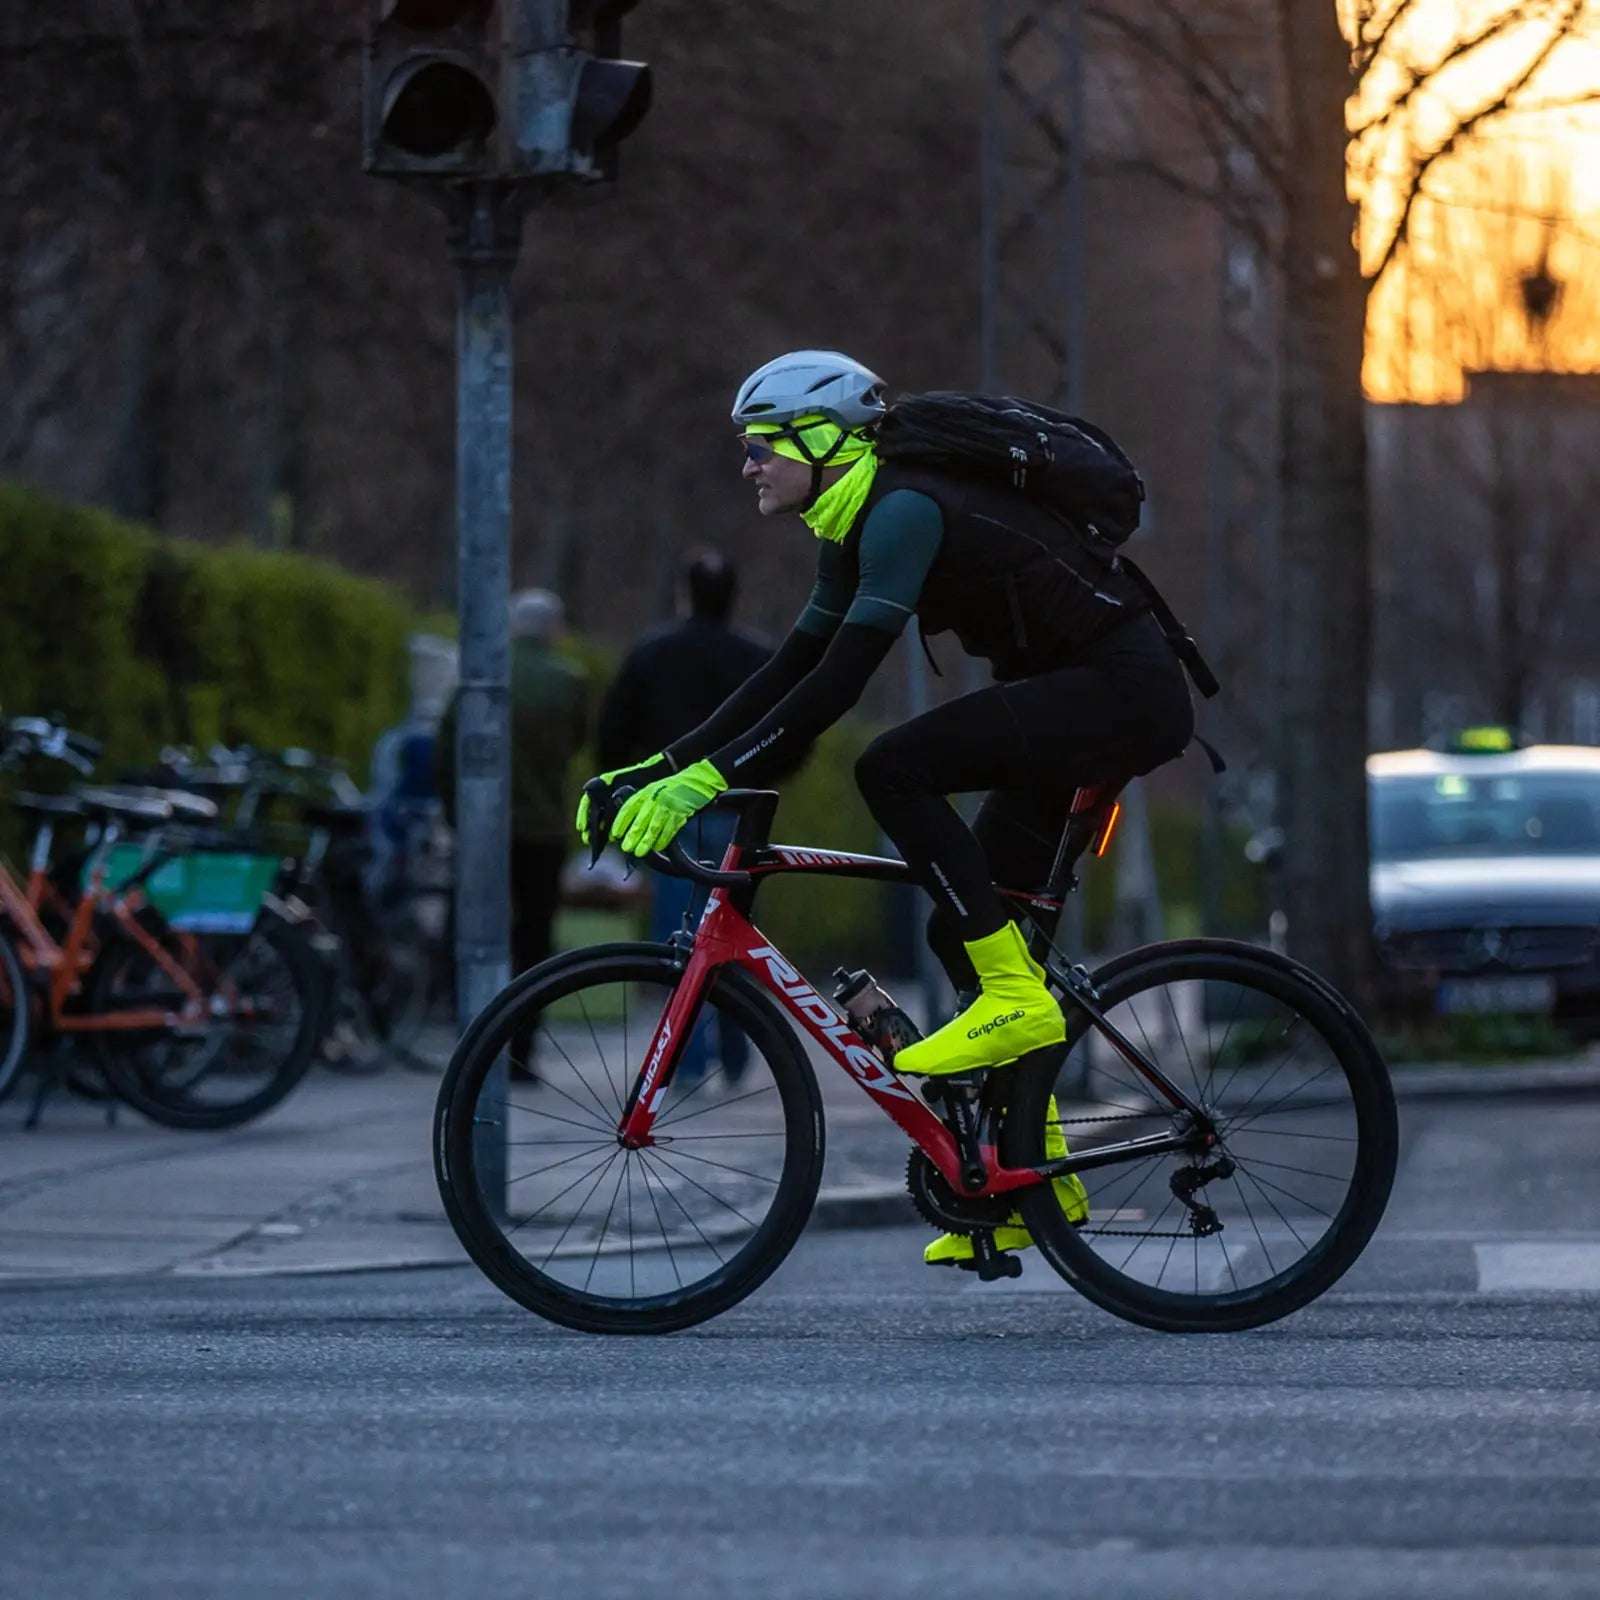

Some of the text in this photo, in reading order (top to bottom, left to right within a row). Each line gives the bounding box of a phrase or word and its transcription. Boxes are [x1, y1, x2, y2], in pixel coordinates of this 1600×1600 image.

[638, 1018, 671, 1104] RIDLEY
[747, 946, 917, 1103] RIDLEY
[967, 1009, 1025, 1040] GripGrab
